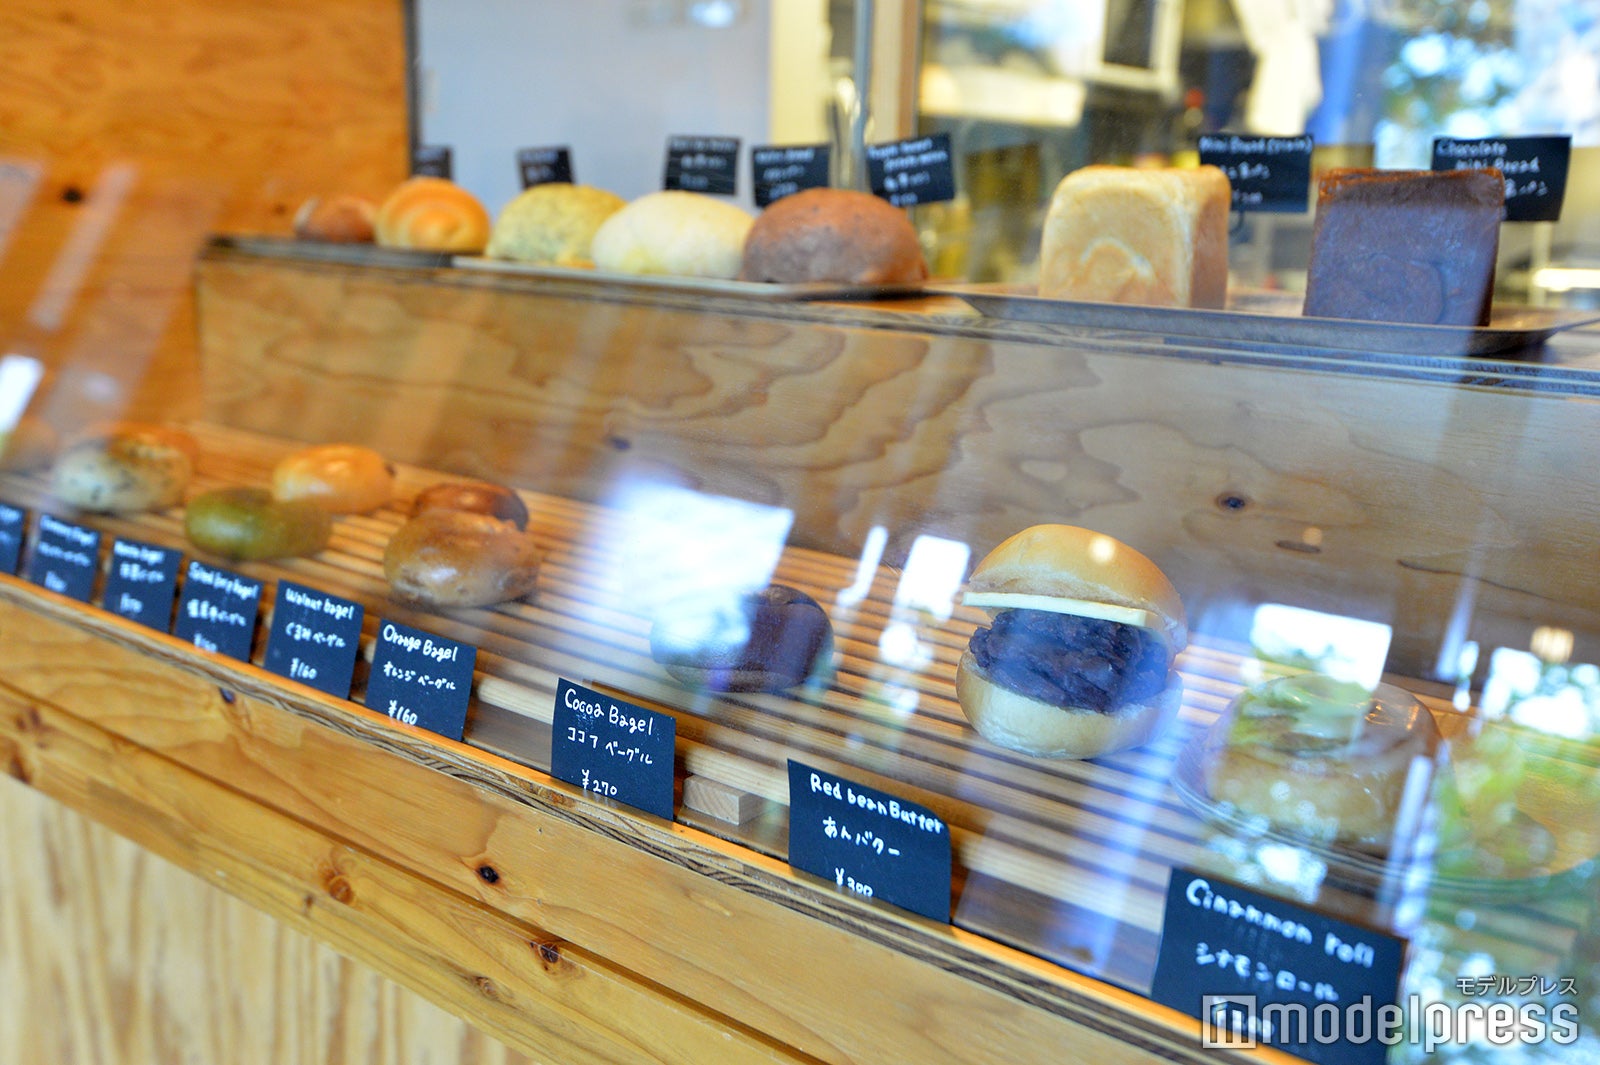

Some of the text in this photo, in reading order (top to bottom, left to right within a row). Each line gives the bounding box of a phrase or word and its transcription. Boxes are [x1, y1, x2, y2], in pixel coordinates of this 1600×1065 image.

[324, 598, 354, 620] bagel
[383, 624, 458, 662] Orange Bagel
[388, 700, 417, 725] ¥160
[564, 688, 653, 736] Cocoa Bagel
[581, 768, 617, 795] ¥270
[810, 773, 945, 834] Red bean Butter
